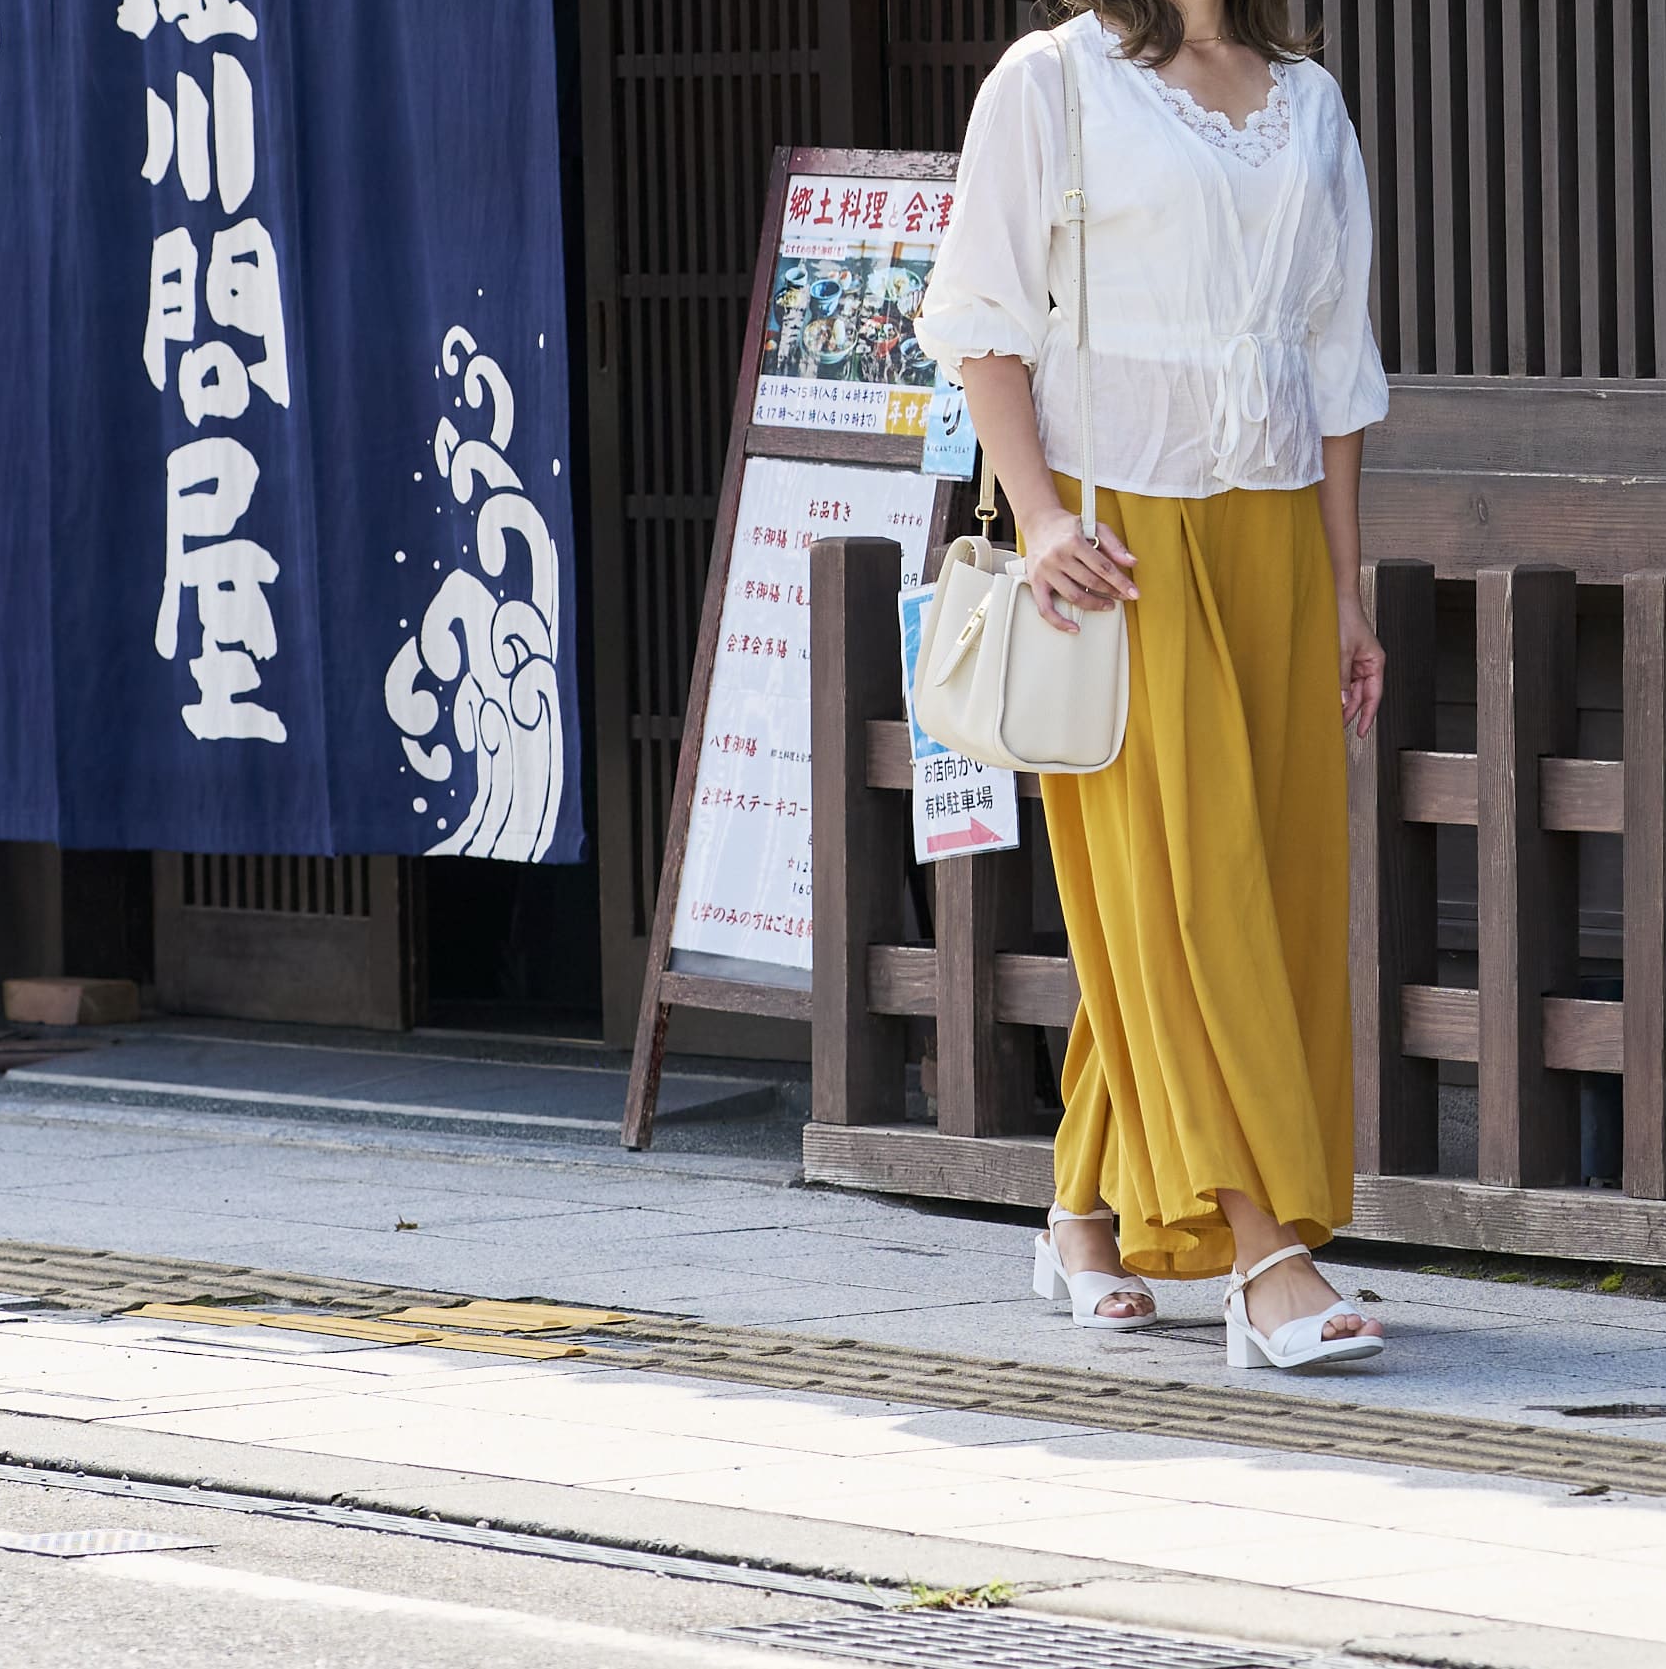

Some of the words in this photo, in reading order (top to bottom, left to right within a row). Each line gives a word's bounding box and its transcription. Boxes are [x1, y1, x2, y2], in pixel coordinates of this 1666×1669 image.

[809, 499, 852, 522] お品書き
[925, 785, 993, 820] 有料駐車場
